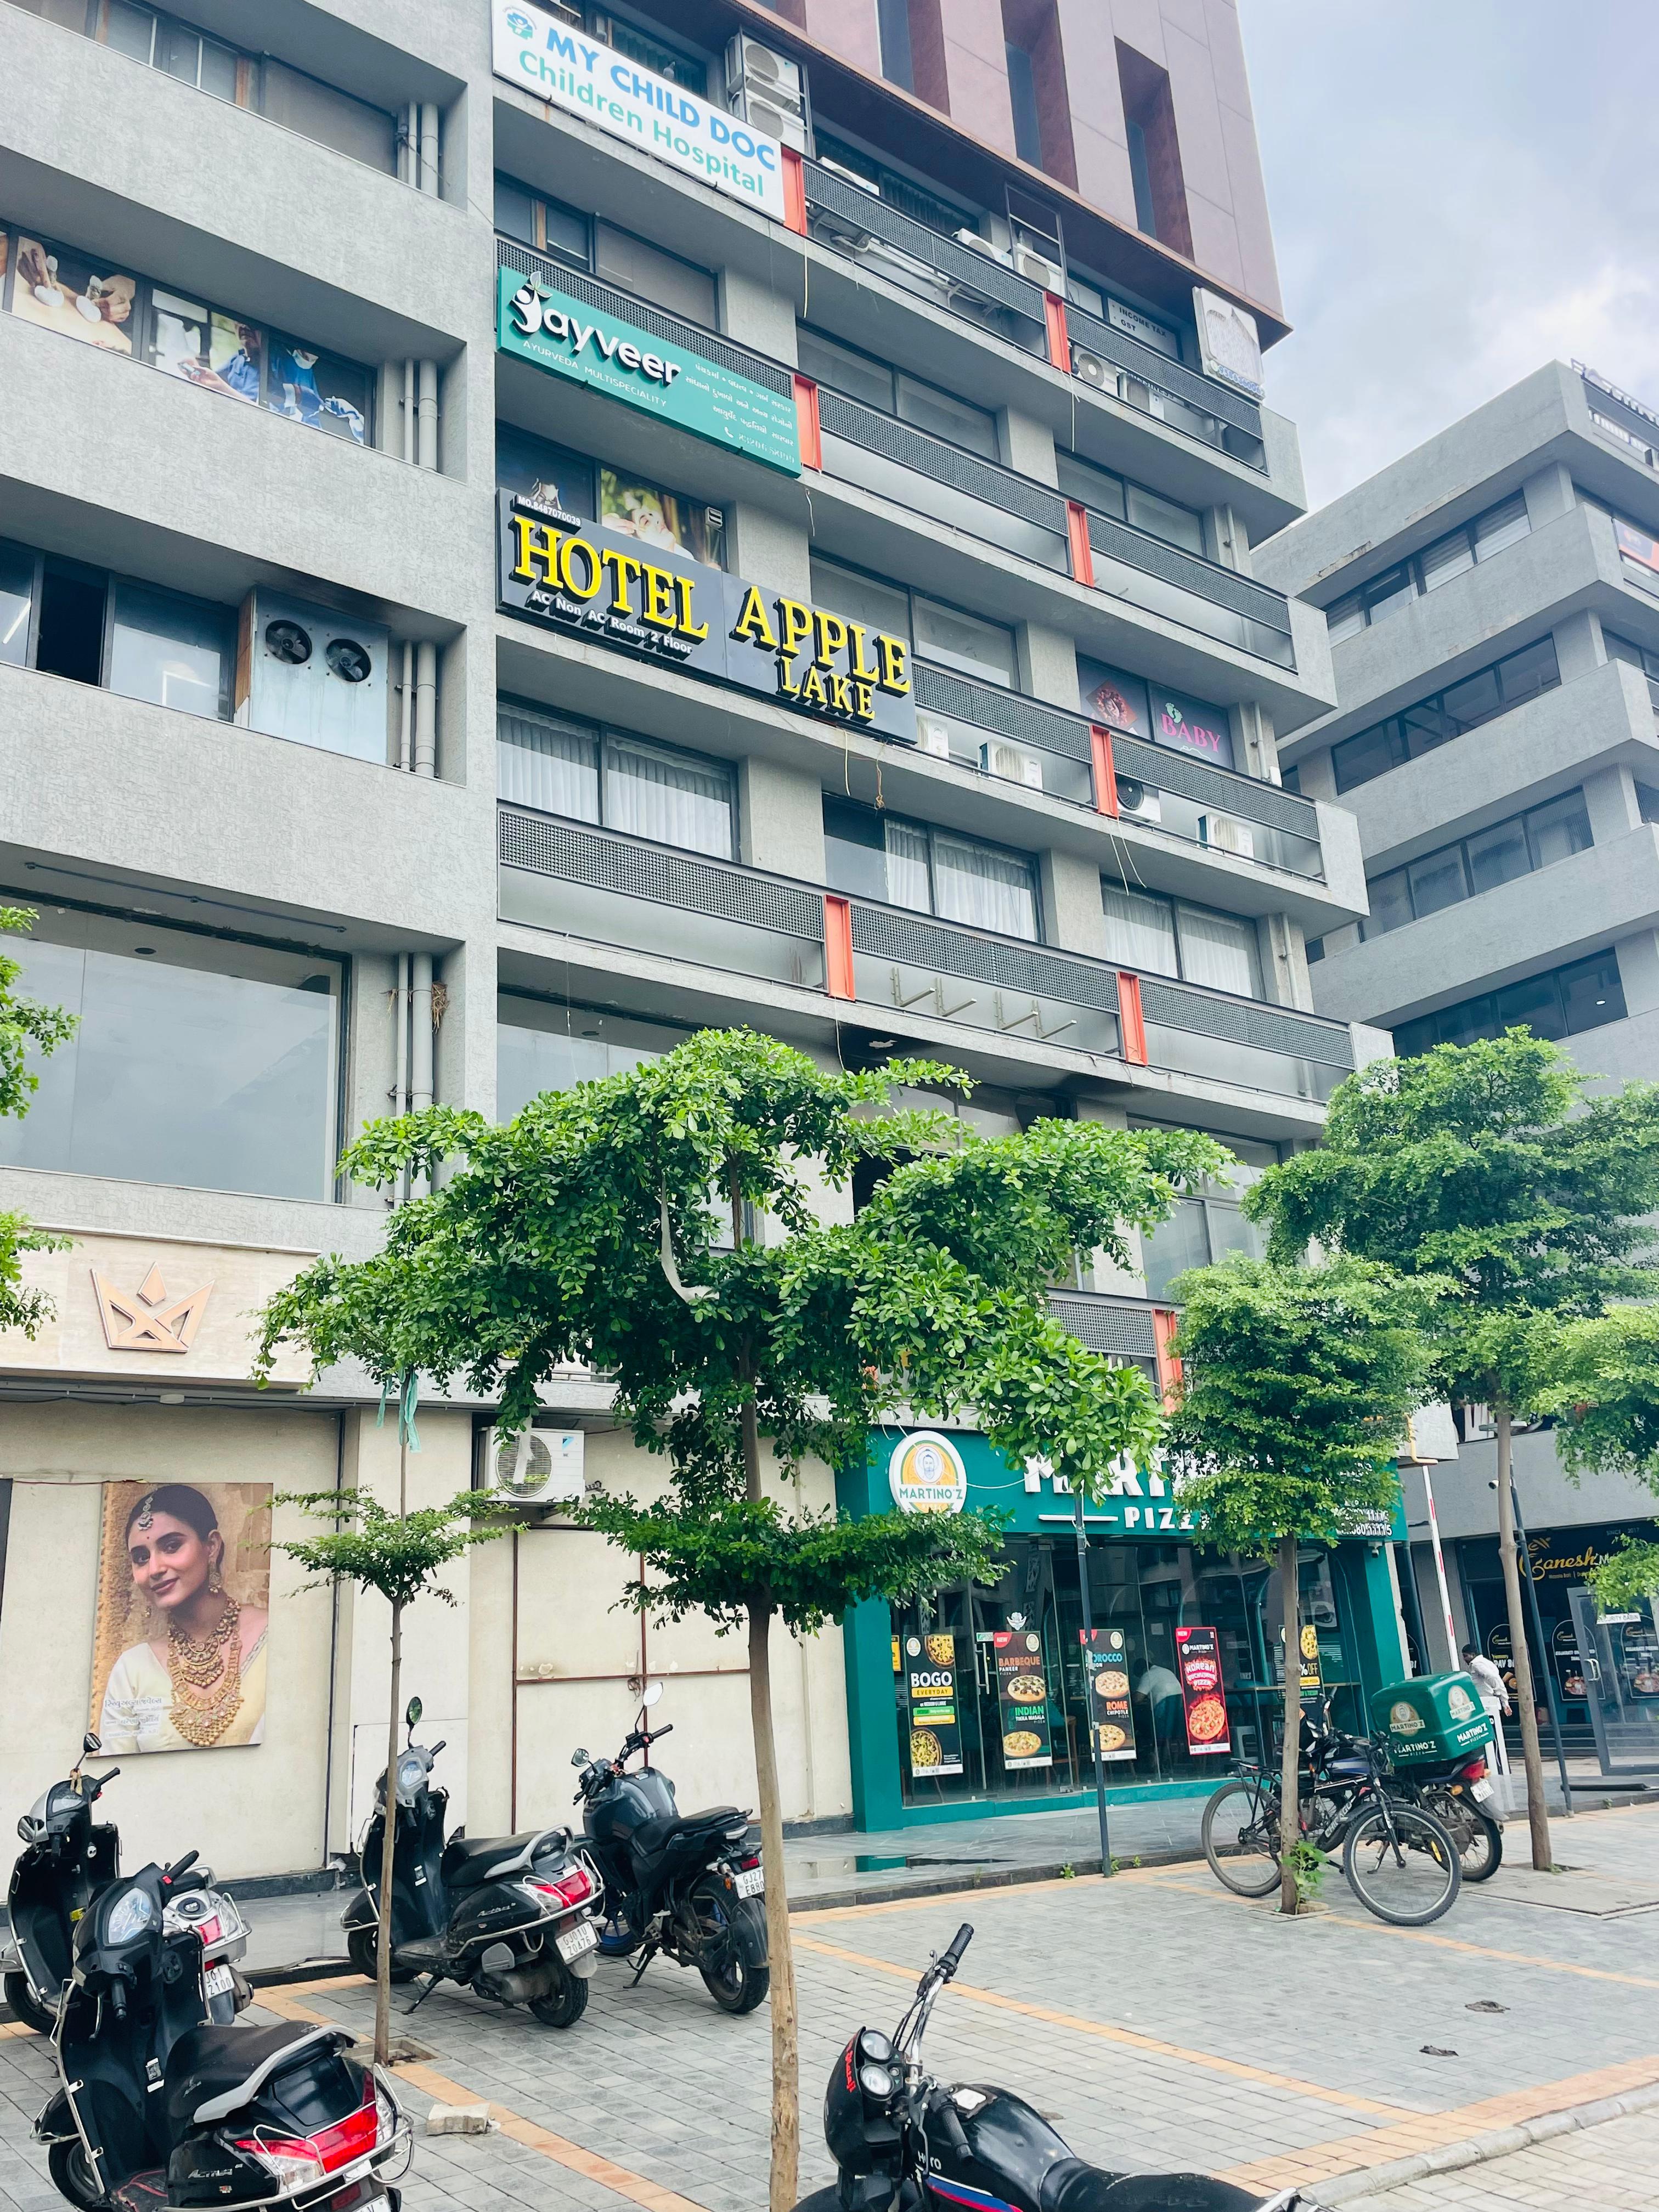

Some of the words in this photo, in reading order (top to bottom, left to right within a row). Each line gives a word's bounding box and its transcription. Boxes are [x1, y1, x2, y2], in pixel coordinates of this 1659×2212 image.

[546, 27, 600, 72] MY
[611, 65, 699, 128] CHILD
[710, 116, 775, 171] DOC
[520, 50, 643, 133] Children
[653, 120, 764, 197] Hospital
[1119, 307, 1150, 328] INCOME
[1152, 325, 1166, 337] TAX
[1121, 319, 1136, 331] GST
[523, 340, 579, 370] AYURVEDA
[585, 366, 667, 407] MULTISPECIALITY
[514, 515, 709, 640] HOTEL
[736, 585, 911, 694] APPLE
[532, 590, 550, 605] AC
[556, 597, 582, 616] Non
[589, 610, 606, 624] AC
[610, 616, 645, 637] Room
[650, 631, 659, 643] 2
[663, 635, 692, 654] Floor
[781, 655, 876, 721] LAKE
[1160, 713, 1221, 753] BABY
[899, 1487, 963, 1499] MARTINO'Z
[1124, 1506, 1211, 1531] PIZZ
[1519, 1546, 1595, 1581] Ganesh
[998, 1656, 1040, 1667] BARBEQUE
[1085, 1652, 1123, 1663] OROCCO
[911, 1671, 952, 1688] BOGO
[1015, 1705, 1045, 1716] INDIAN
[1106, 1701, 1128, 1711] ROME
[743, 1870, 761, 1884] GJ27
[205, 1968, 222, 1983] J01
